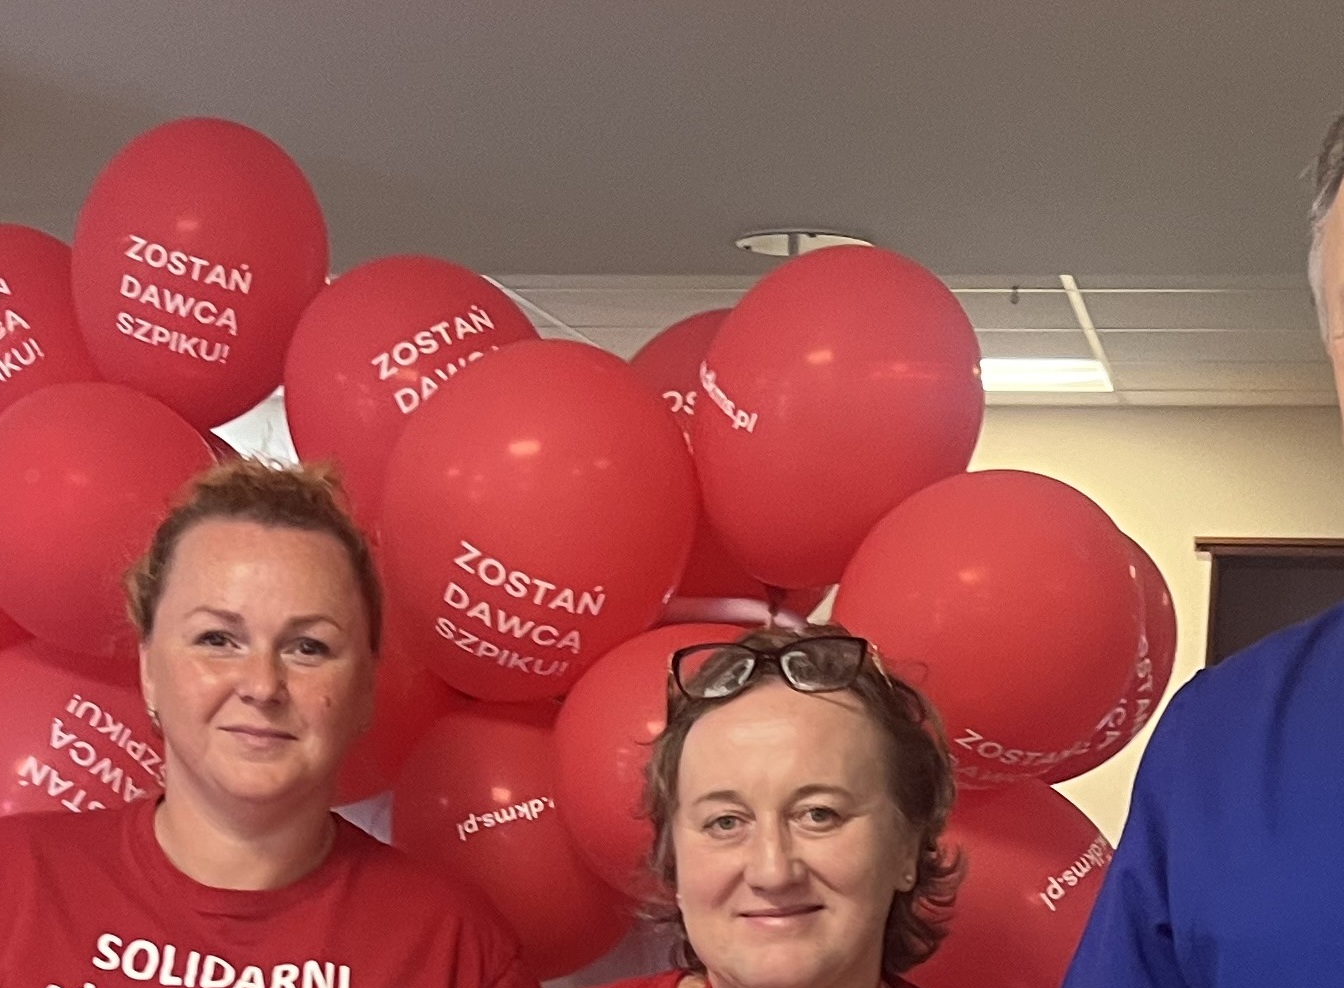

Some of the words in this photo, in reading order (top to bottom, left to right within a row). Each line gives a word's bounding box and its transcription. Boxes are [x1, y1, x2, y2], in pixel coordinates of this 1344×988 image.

[124, 234, 252, 294] ZOSTAŃ
[116, 312, 230, 364] SZPIKU!
[120, 274, 237, 336] DAWCĄ
[371, 305, 495, 380] ZOSTAŃ
[453, 539, 606, 616] ZOSTAŃ
[435, 617, 570, 677] SZPIKU!
[443, 581, 581, 655] DAWCĄ
[50, 717, 147, 803] AWCĄ
